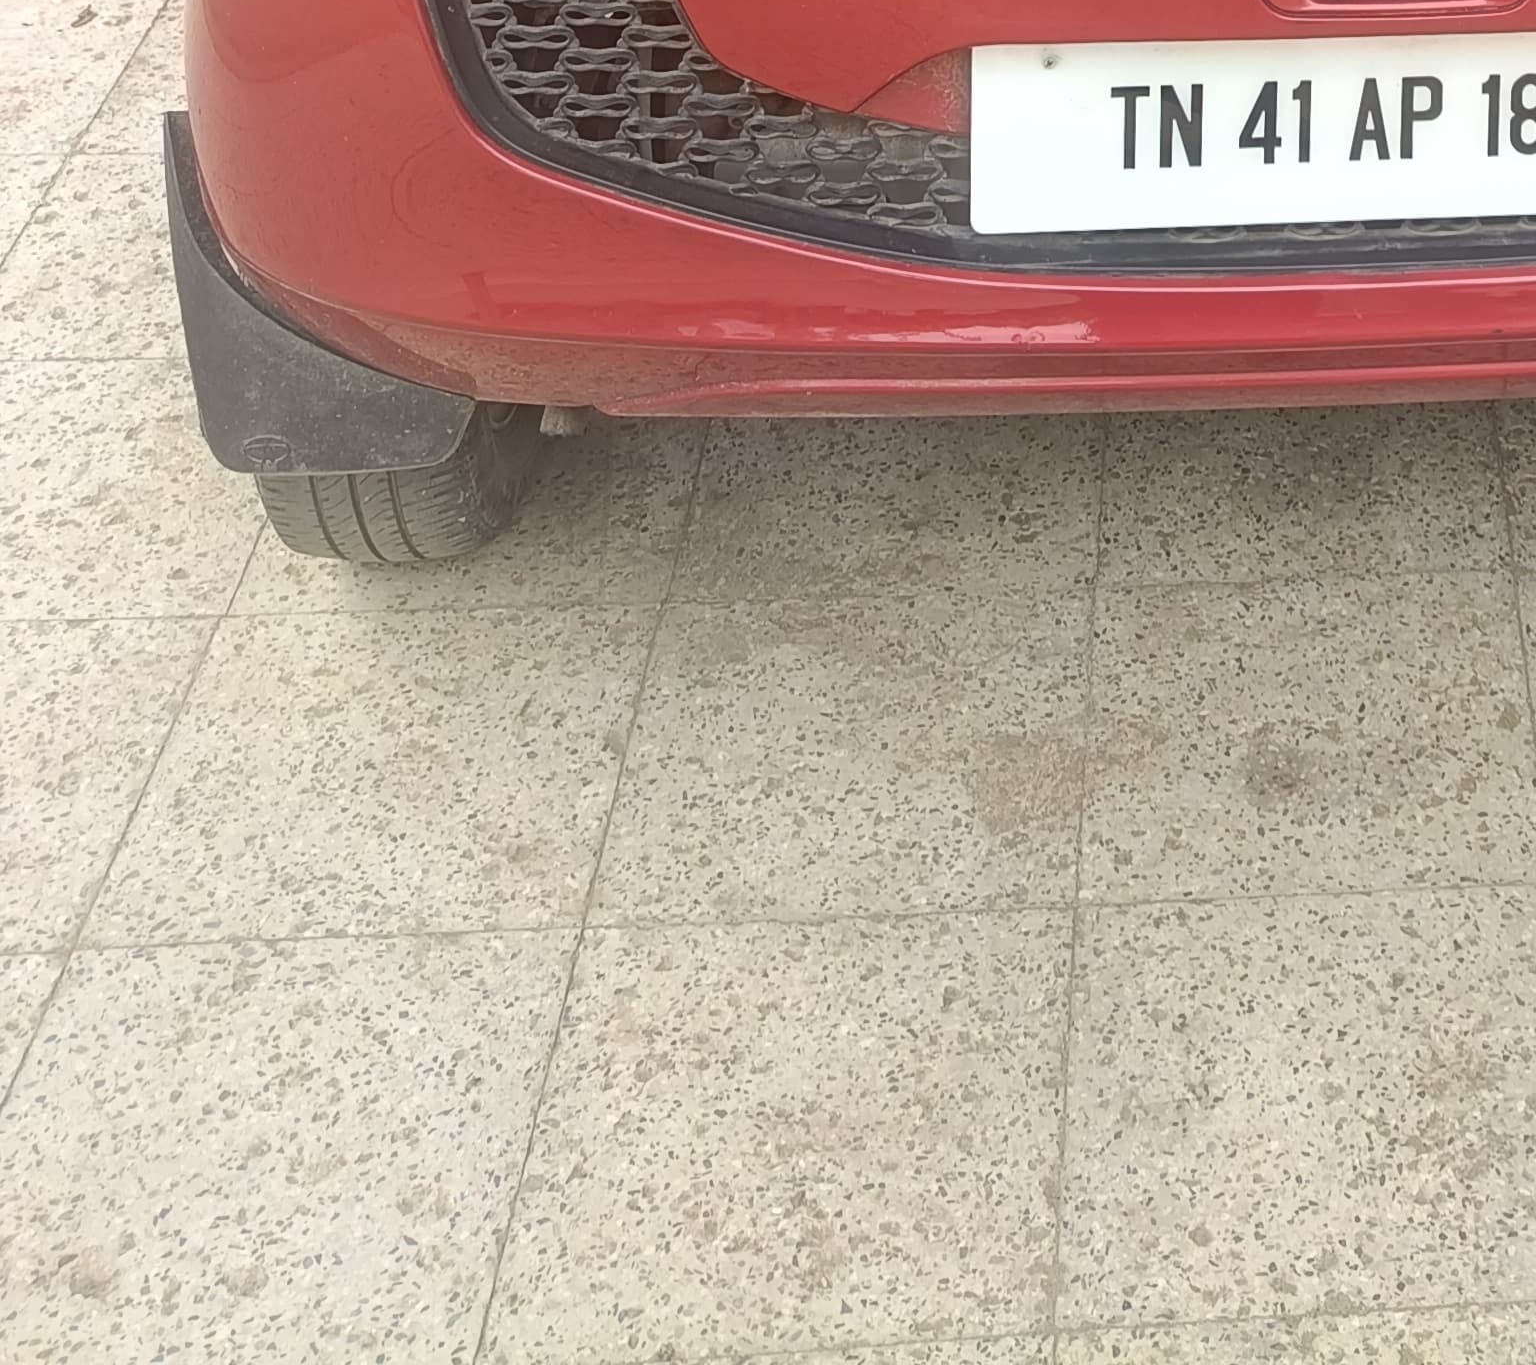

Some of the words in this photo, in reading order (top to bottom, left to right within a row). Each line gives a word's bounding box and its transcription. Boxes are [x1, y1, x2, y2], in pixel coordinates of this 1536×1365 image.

[1110, 84, 1204, 170] TN
[1238, 80, 1312, 164] 41
[1349, 76, 1443, 161] AP
